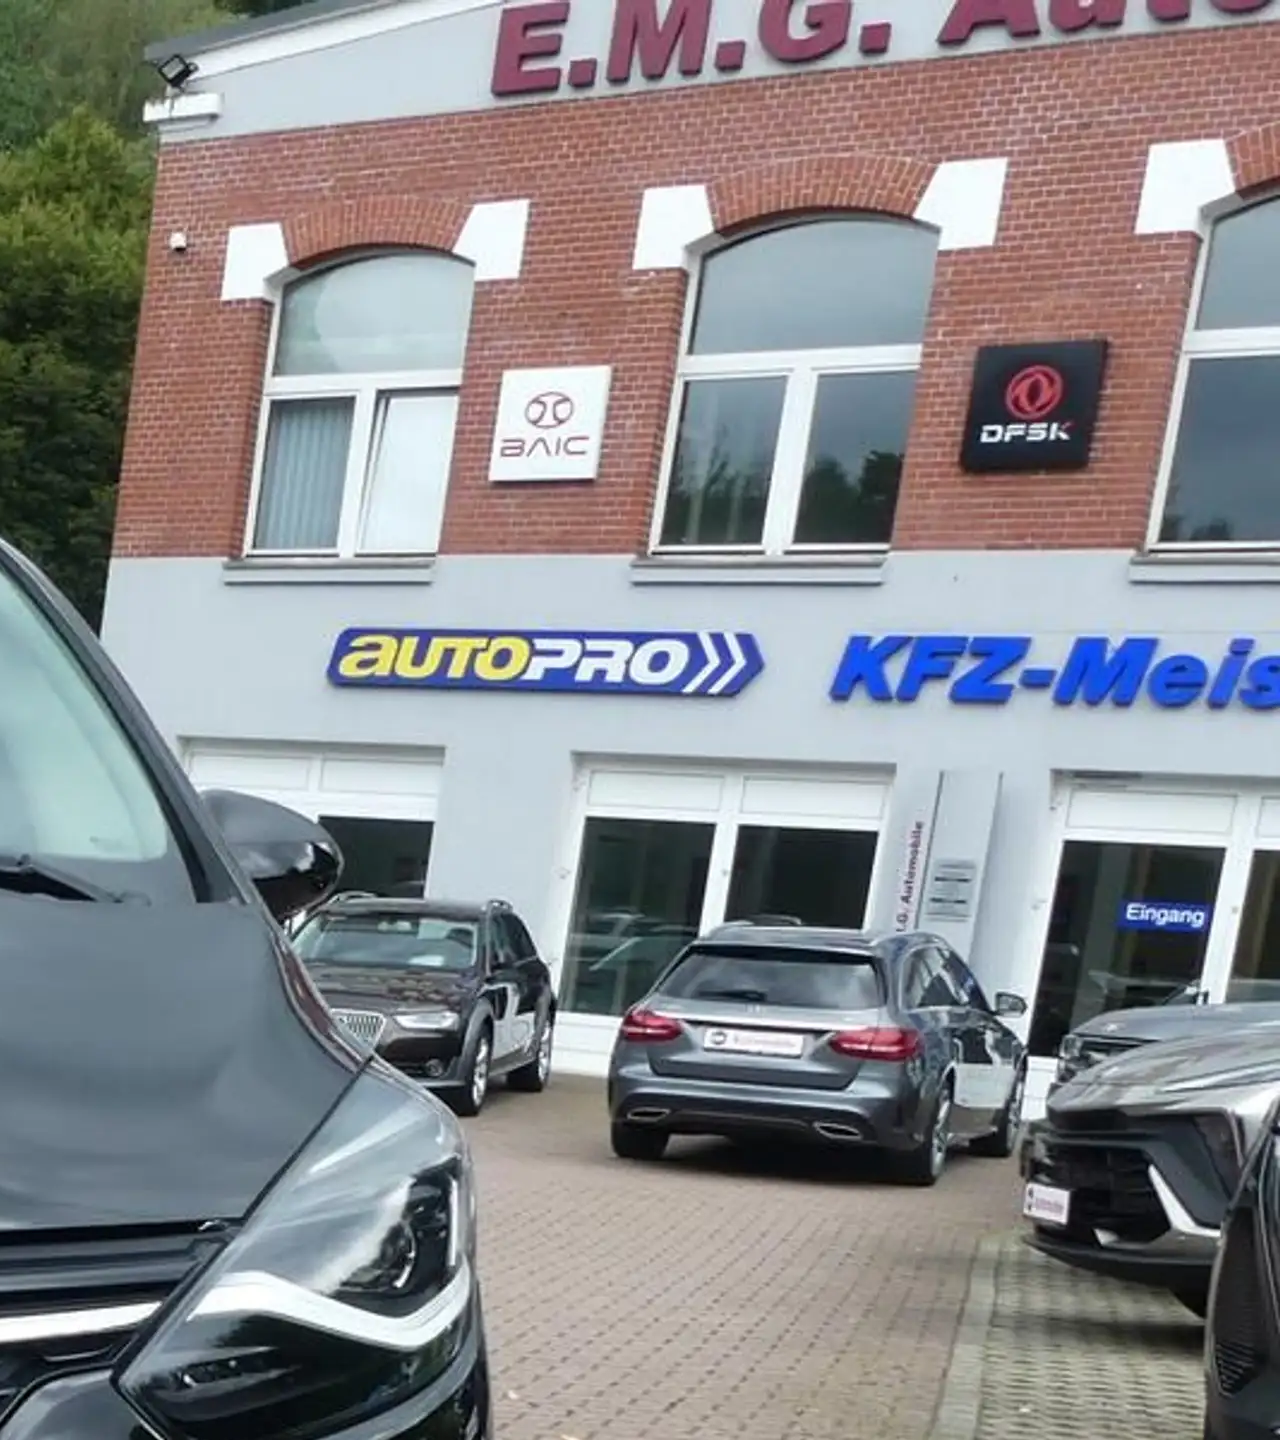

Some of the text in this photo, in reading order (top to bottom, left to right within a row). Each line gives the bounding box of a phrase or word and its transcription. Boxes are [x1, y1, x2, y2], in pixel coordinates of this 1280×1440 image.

[491, 0, 892, 96] E.M.G.
[979, 421, 1074, 443] DFSK
[500, 435, 590, 458] BAIC
[828, 635, 1280, 710] KFZ-Meis
[1126, 902, 1205, 928] Eingang
